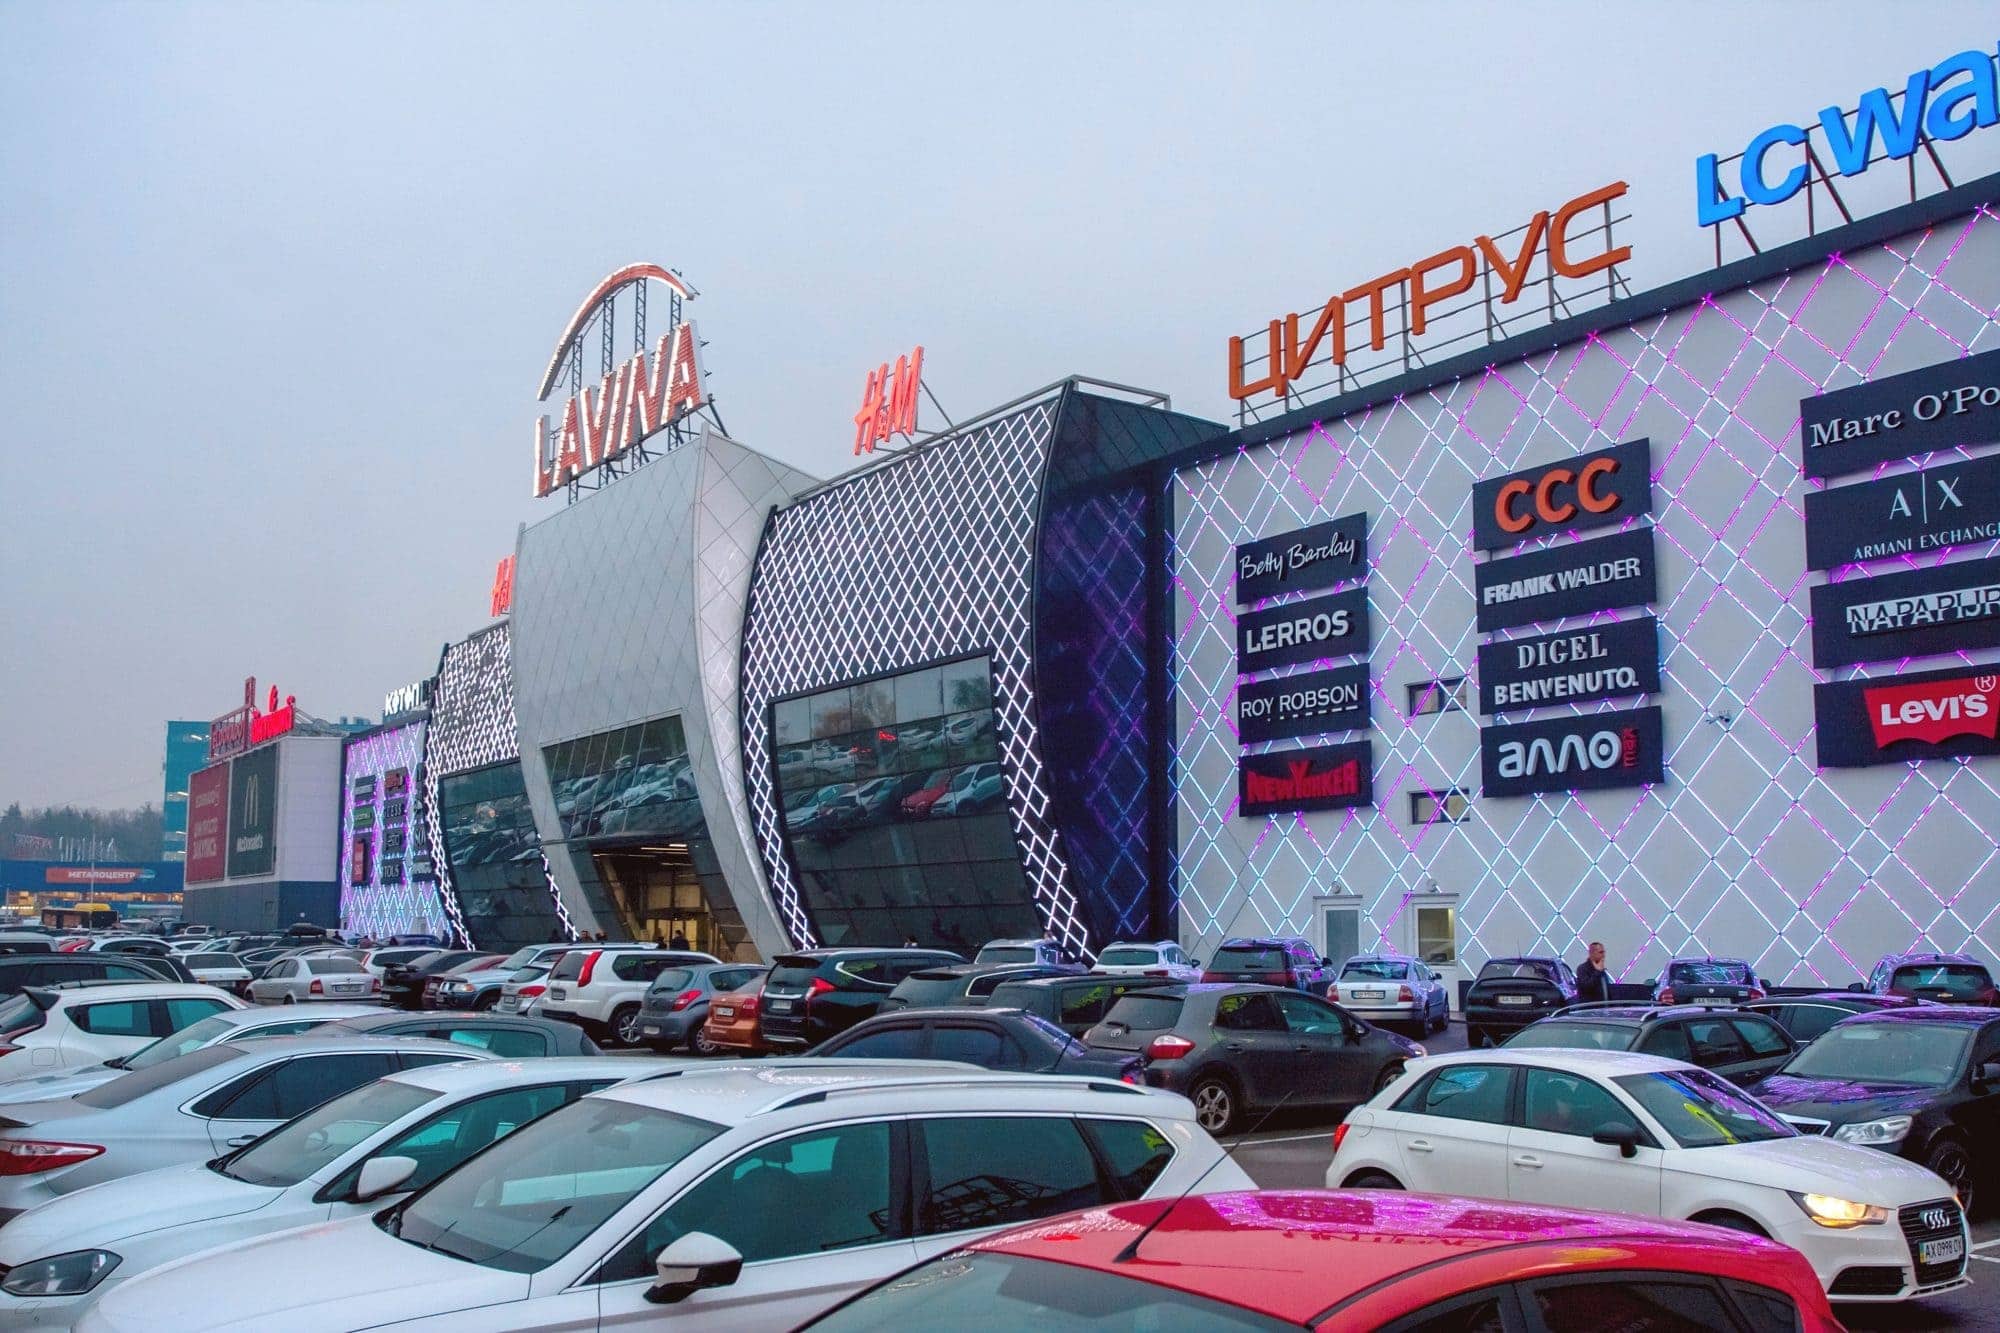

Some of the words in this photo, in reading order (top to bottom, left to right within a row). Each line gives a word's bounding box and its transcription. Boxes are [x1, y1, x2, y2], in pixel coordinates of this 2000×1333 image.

[1229, 180, 1632, 400] ЦИТРУС
[533, 319, 706, 498] LAVINA
[1810, 409, 1902, 448] Marc
[1495, 457, 1620, 533] CCC
[1239, 551, 1283, 581] Betty
[1288, 531, 1355, 569] Barclay
[1854, 537, 1913, 560] ARMANI
[1920, 522, 2000, 549] EXCHANG
[1483, 573, 1557, 606] FRANK
[1557, 557, 1641, 591] WALDER
[1246, 609, 1349, 654] LERROS
[1517, 633, 1608, 669] DIGEL
[1241, 696, 1274, 719] ROY
[1279, 683, 1358, 713] ROBSON
